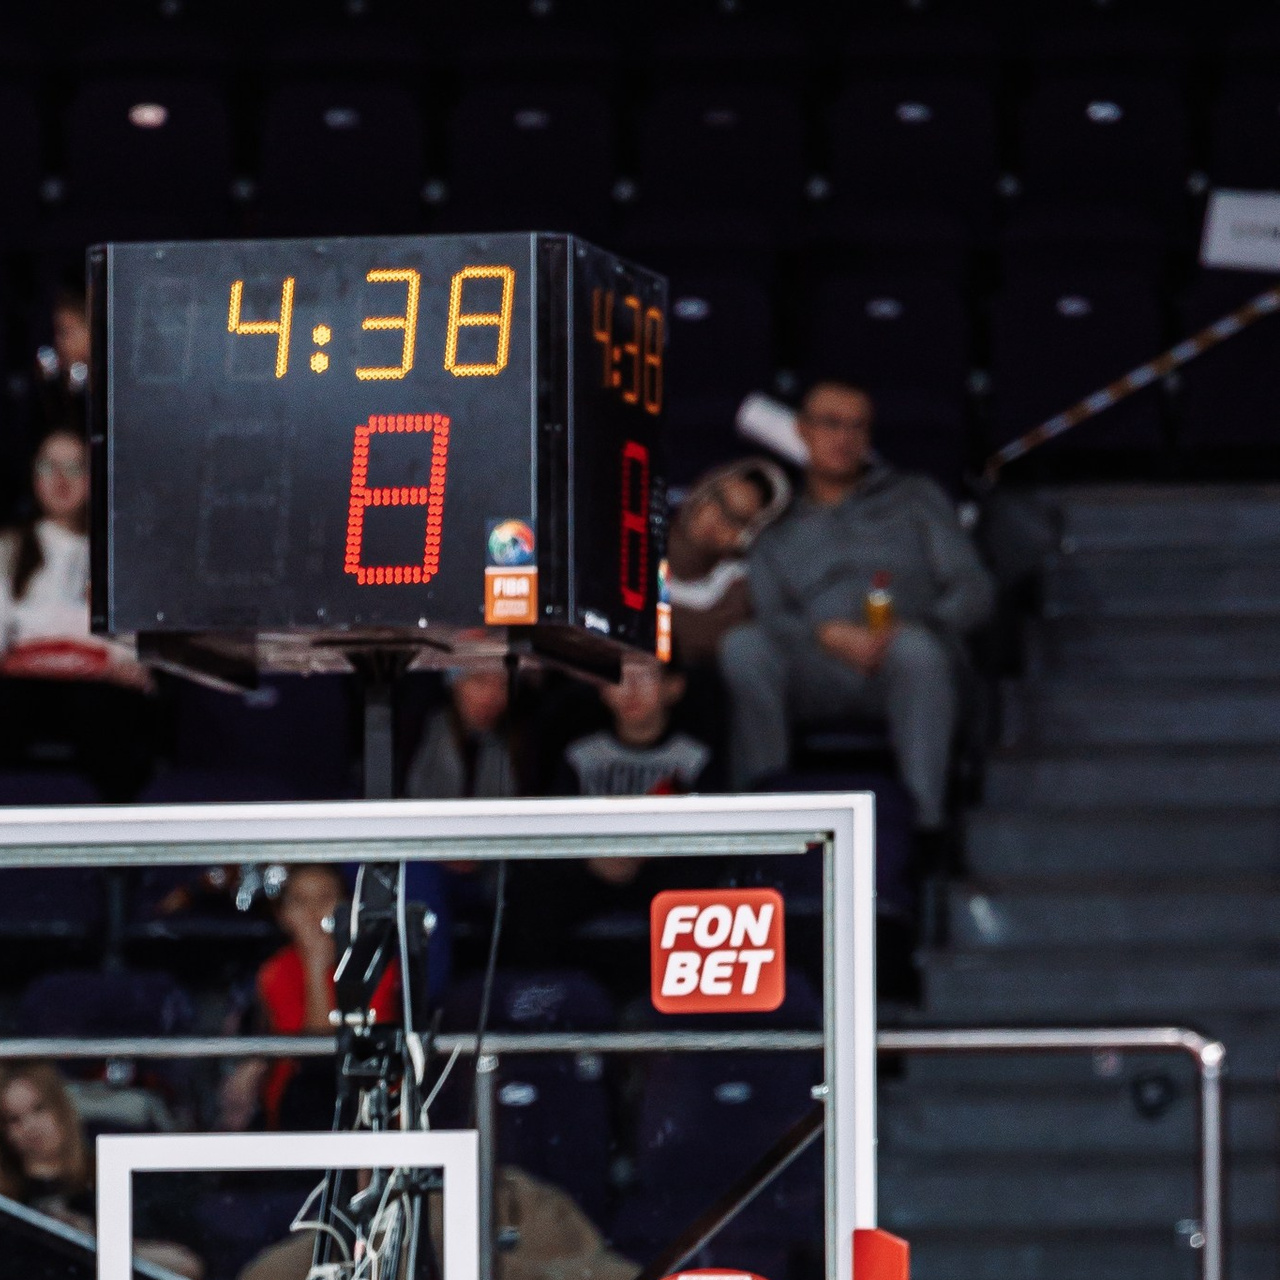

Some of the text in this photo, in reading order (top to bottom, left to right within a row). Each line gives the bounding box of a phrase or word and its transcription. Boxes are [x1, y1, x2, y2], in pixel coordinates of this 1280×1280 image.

[228, 265, 515, 381] 4:38
[344, 412, 451, 586] 8
[621, 440, 649, 611] 8
[660, 903, 774, 948] FON
[661, 949, 775, 997] BET
